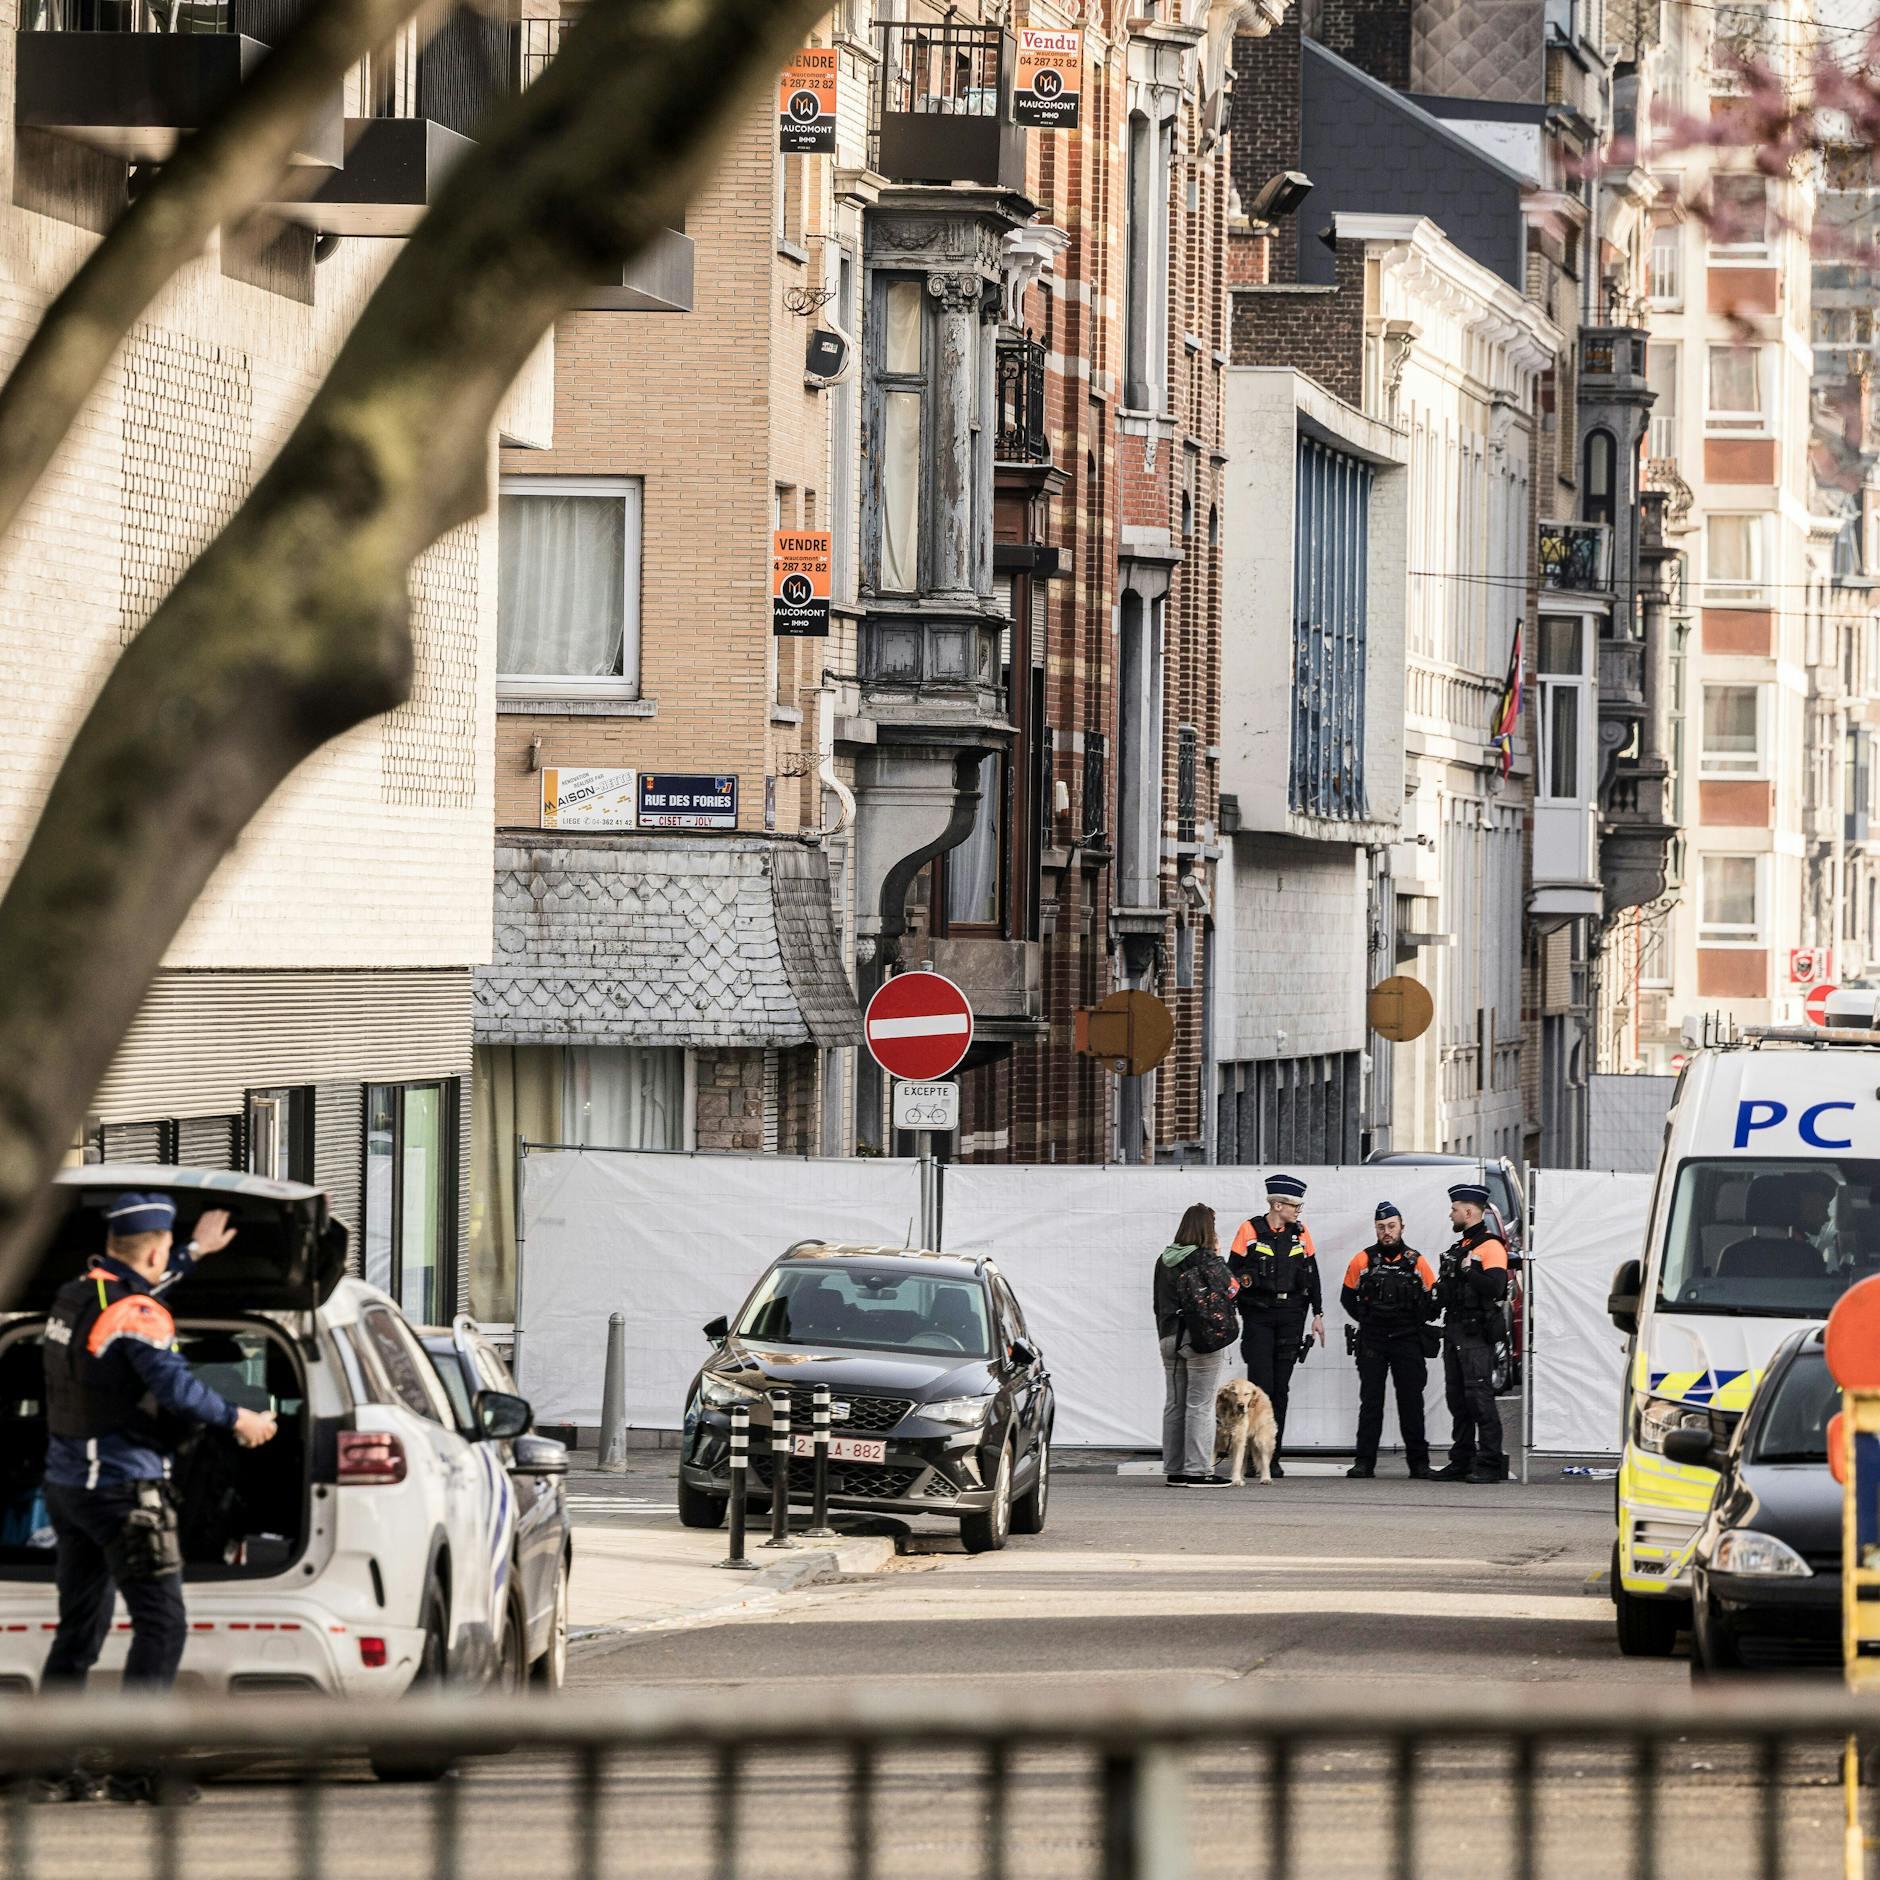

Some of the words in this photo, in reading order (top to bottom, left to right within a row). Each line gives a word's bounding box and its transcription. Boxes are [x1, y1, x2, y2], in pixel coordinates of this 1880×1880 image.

[1023, 32, 1077, 51] Vendu
[788, 56, 834, 68] VENDRE
[1020, 57, 1031, 65] 04
[1034, 58, 1050, 66] 287
[1053, 58, 1063, 67] 32
[1066, 59, 1077, 68] 82
[790, 79, 806, 88] 287
[809, 80, 819, 88] 32
[822, 80, 834, 89] 82
[1019, 100, 1075, 110] WAUCOMONT
[779, 538, 827, 552] VENDRE
[782, 563, 799, 571] 287
[801, 563, 812, 572] 32
[815, 563, 827, 572] 82
[644, 794, 666, 806] RUE
[669, 795, 690, 807] DES
[693, 795, 732, 808] FORIES
[562, 817, 580, 825] LIEGE
[658, 817, 682, 826] CISET
[695, 817, 713, 826] JOLY
[904, 1087, 949, 1097] EXCEPTE
[1733, 1100, 1857, 1149] PC
[797, 1439, 881, 1459] 2-A-882
